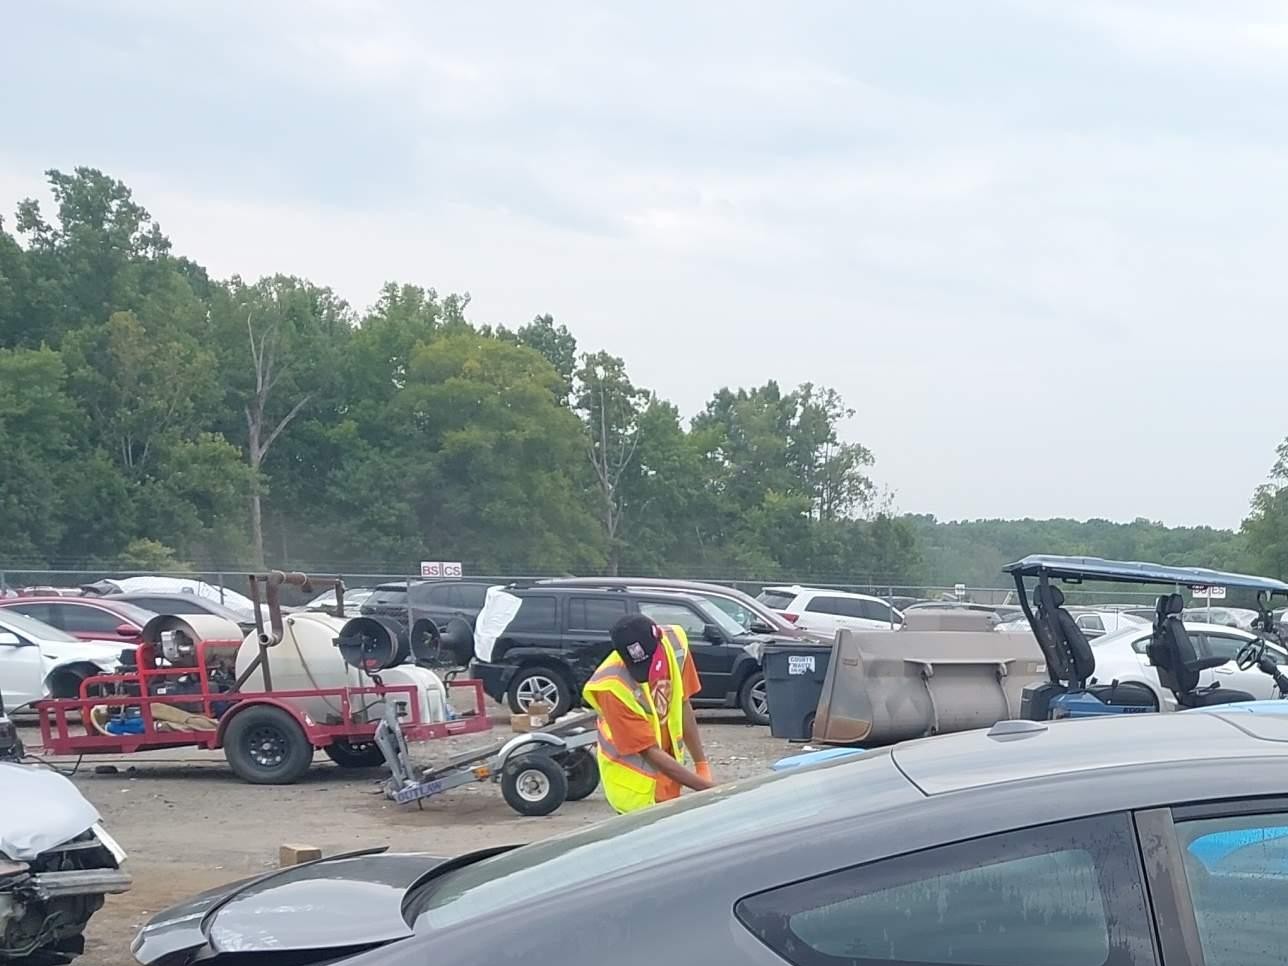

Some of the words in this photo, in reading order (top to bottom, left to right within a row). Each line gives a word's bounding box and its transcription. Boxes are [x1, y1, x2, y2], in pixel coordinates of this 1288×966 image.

[422, 566, 439, 576] BS
[444, 566, 461, 576] CS
[397, 782, 442, 801] OUTLAW
